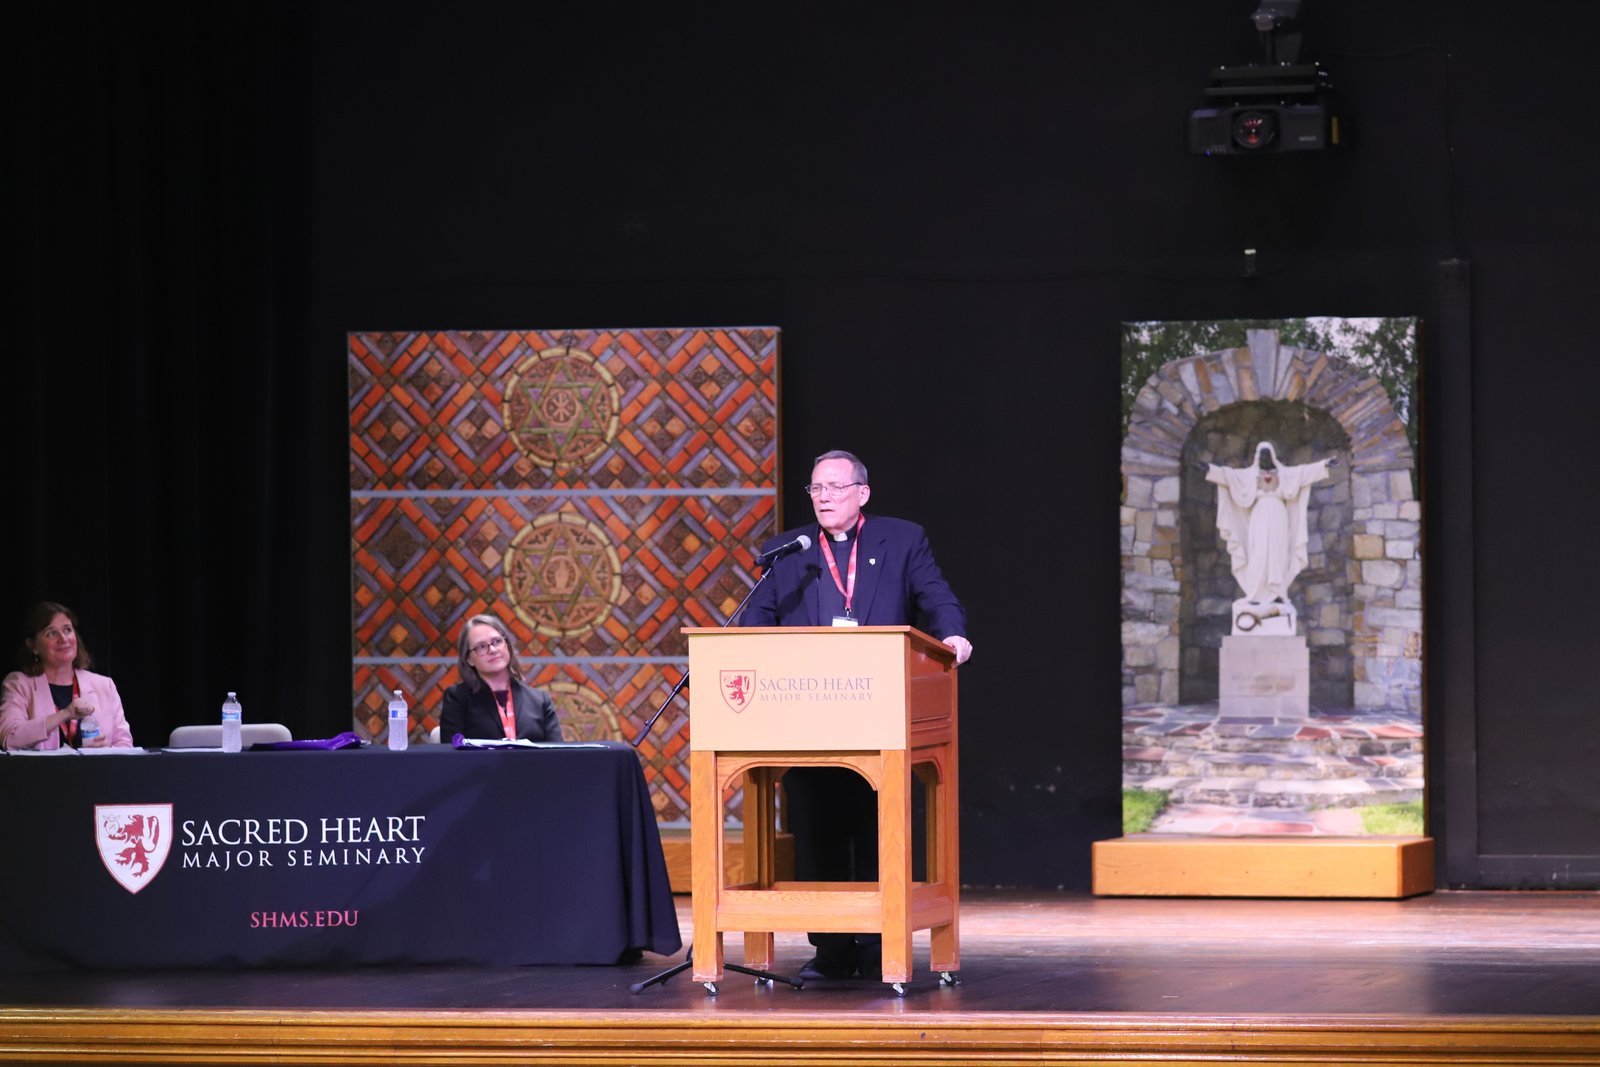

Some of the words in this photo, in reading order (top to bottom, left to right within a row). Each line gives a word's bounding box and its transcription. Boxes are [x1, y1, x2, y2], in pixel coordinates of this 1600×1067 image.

[760, 677, 818, 691] SACRED
[823, 677, 873, 690] HEART
[760, 693, 801, 702] MAJOR
[808, 692, 873, 701] SEMINARY
[181, 818, 309, 846] SACRED
[320, 815, 426, 844] HEART
[182, 850, 274, 871] MAJOR
[287, 847, 426, 867] SEMINARY
[250, 910, 359, 928] SHMS.EDU
